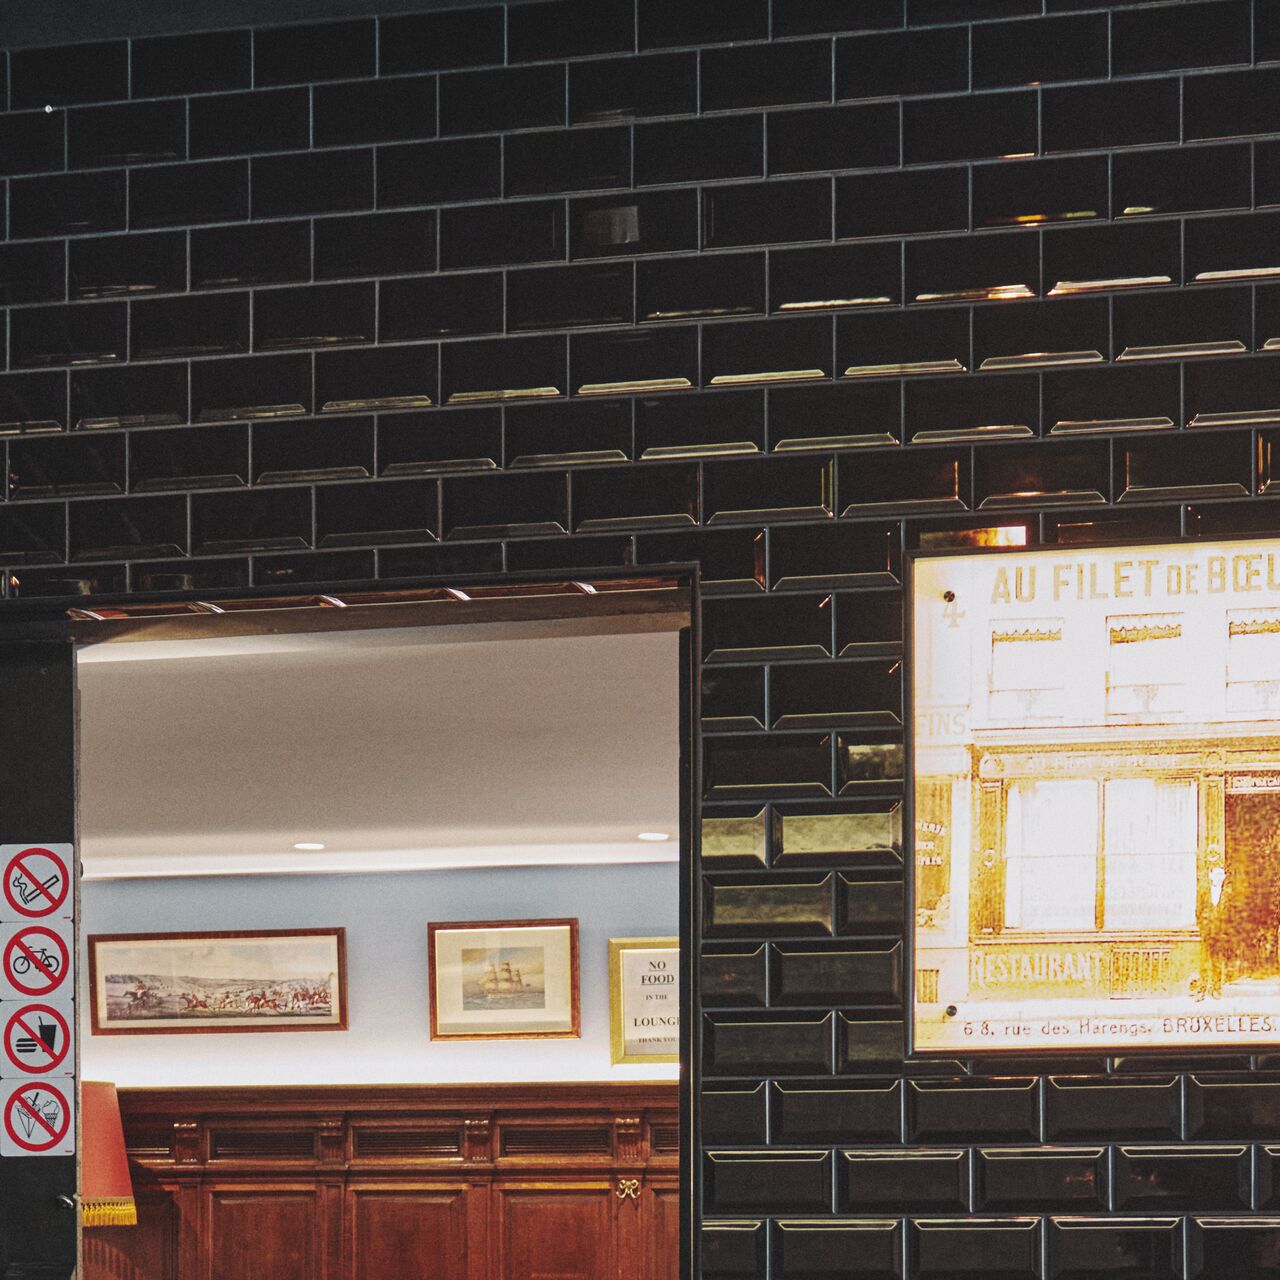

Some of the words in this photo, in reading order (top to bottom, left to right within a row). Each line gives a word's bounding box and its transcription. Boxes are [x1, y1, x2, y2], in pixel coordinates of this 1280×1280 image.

[990, 564, 1036, 604] AU
[1053, 559, 1160, 601] FILET
[1166, 564, 1199, 595] DE
[649, 961, 666, 970] NO
[969, 951, 1104, 987] RESTAURANT
[641, 974, 675, 985] FOOD
[1005, 1023, 1031, 1036] rue
[1041, 1021, 1070, 1035] des
